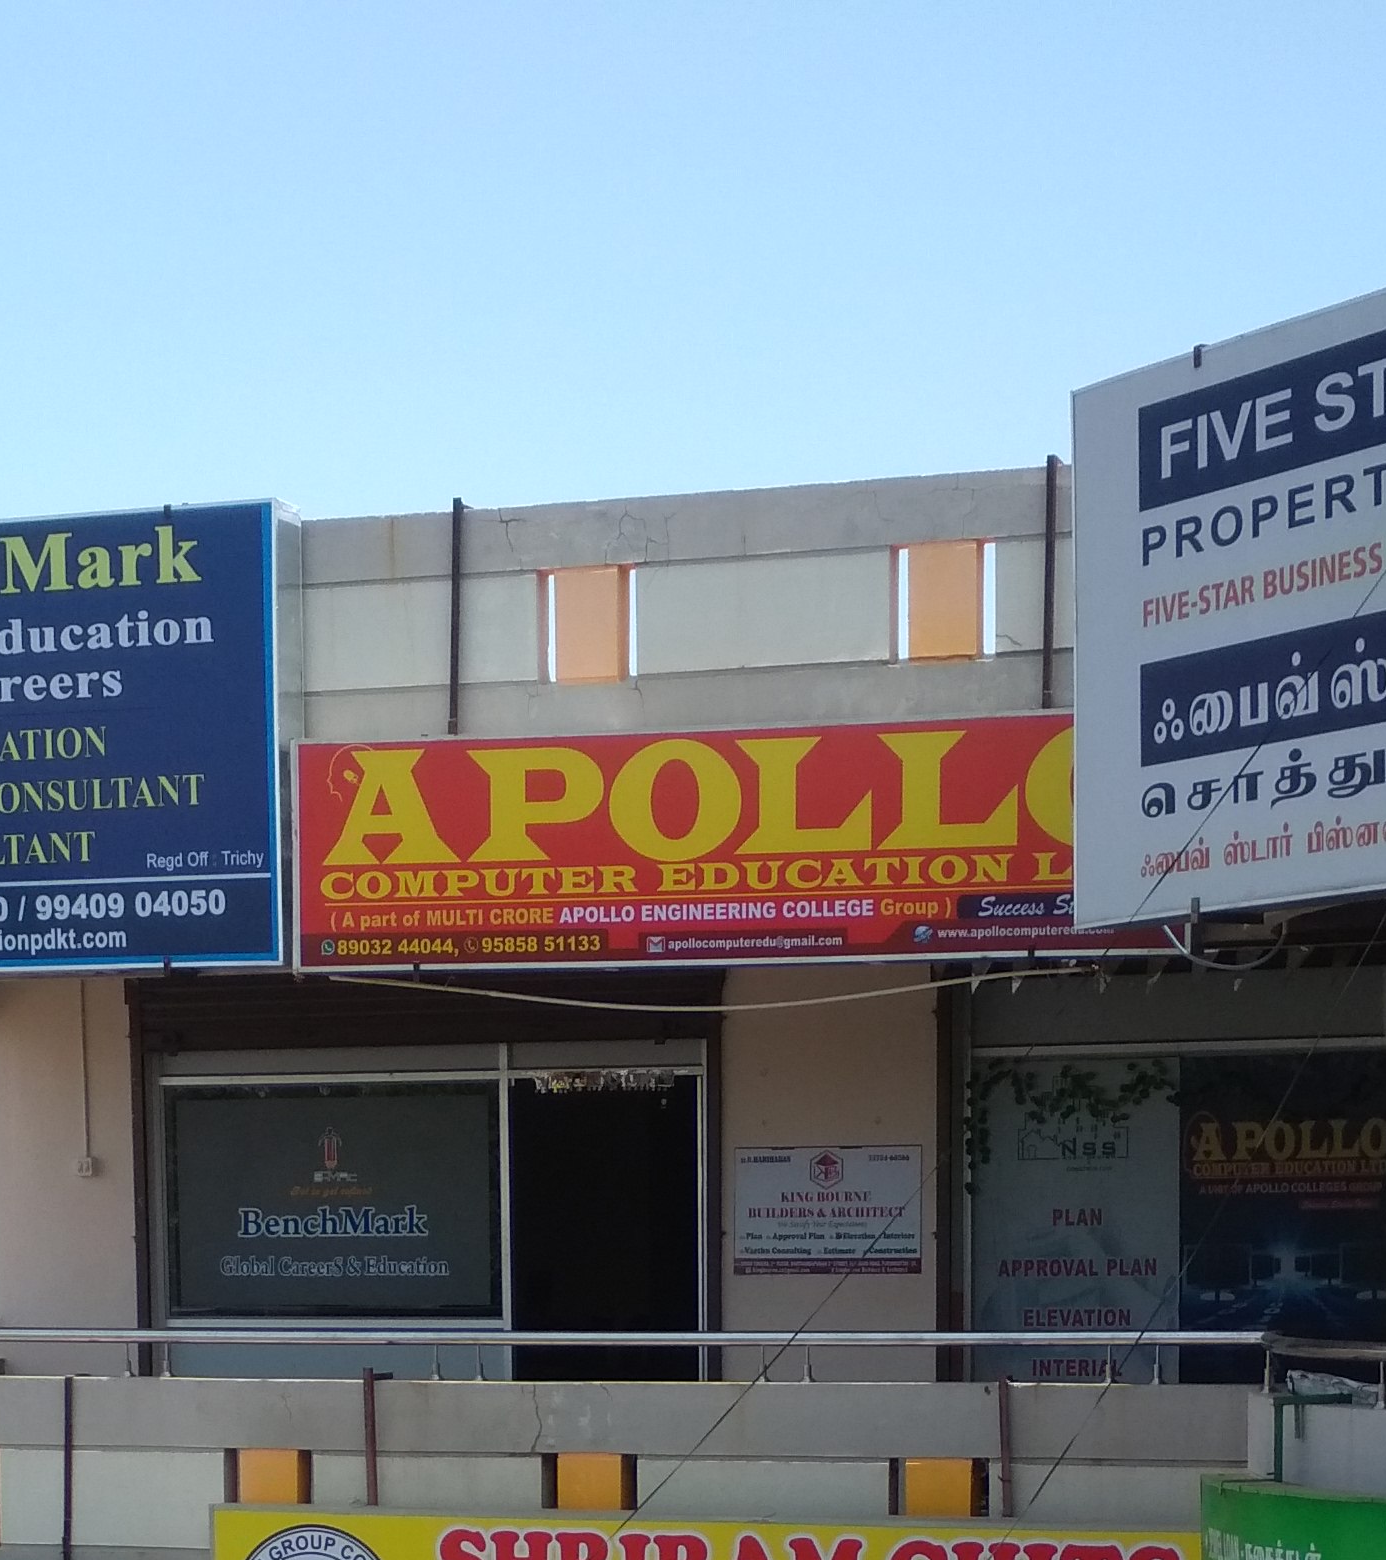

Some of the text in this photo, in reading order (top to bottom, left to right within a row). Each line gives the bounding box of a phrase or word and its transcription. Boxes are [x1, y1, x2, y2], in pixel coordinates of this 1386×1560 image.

[1160, 388, 1292, 480] FIVE
[1142, 578, 1255, 628] FIVE-STAR
[1263, 544, 1382, 598] BUSINESS
[146, 848, 264, 870] Regd Trichy
[321, 853, 1014, 900] COMPUTER EDUCATION
[36, 893, 125, 921] 99409
[134, 889, 226, 918] 04050
[361, 898, 939, 928] part of MULTI CRORE APOLLO ENGINEERING COLLEGE Group
[978, 896, 1045, 916] Success
[337, 939, 391, 954] 89032
[482, 937, 538, 953] 95858
[544, 935, 600, 951] 51133
[1276, 1161, 1356, 1175] EDUCATION
[781, 1192, 813, 1203] KING
[1245, 1183, 1289, 1194] APOLLO
[238, 1205, 429, 1238] BenchMark
[748, 1206, 905, 1218] BUILDERS ARCHITECT
[1052, 1209, 1103, 1226] PLAN
[220, 1255, 449, 1276] Global Education
[999, 1258, 1157, 1277] APPROVAL PLAN
[1023, 1309, 1131, 1327] ELEVATION
[269, 1535, 336, 1560] GROUP
